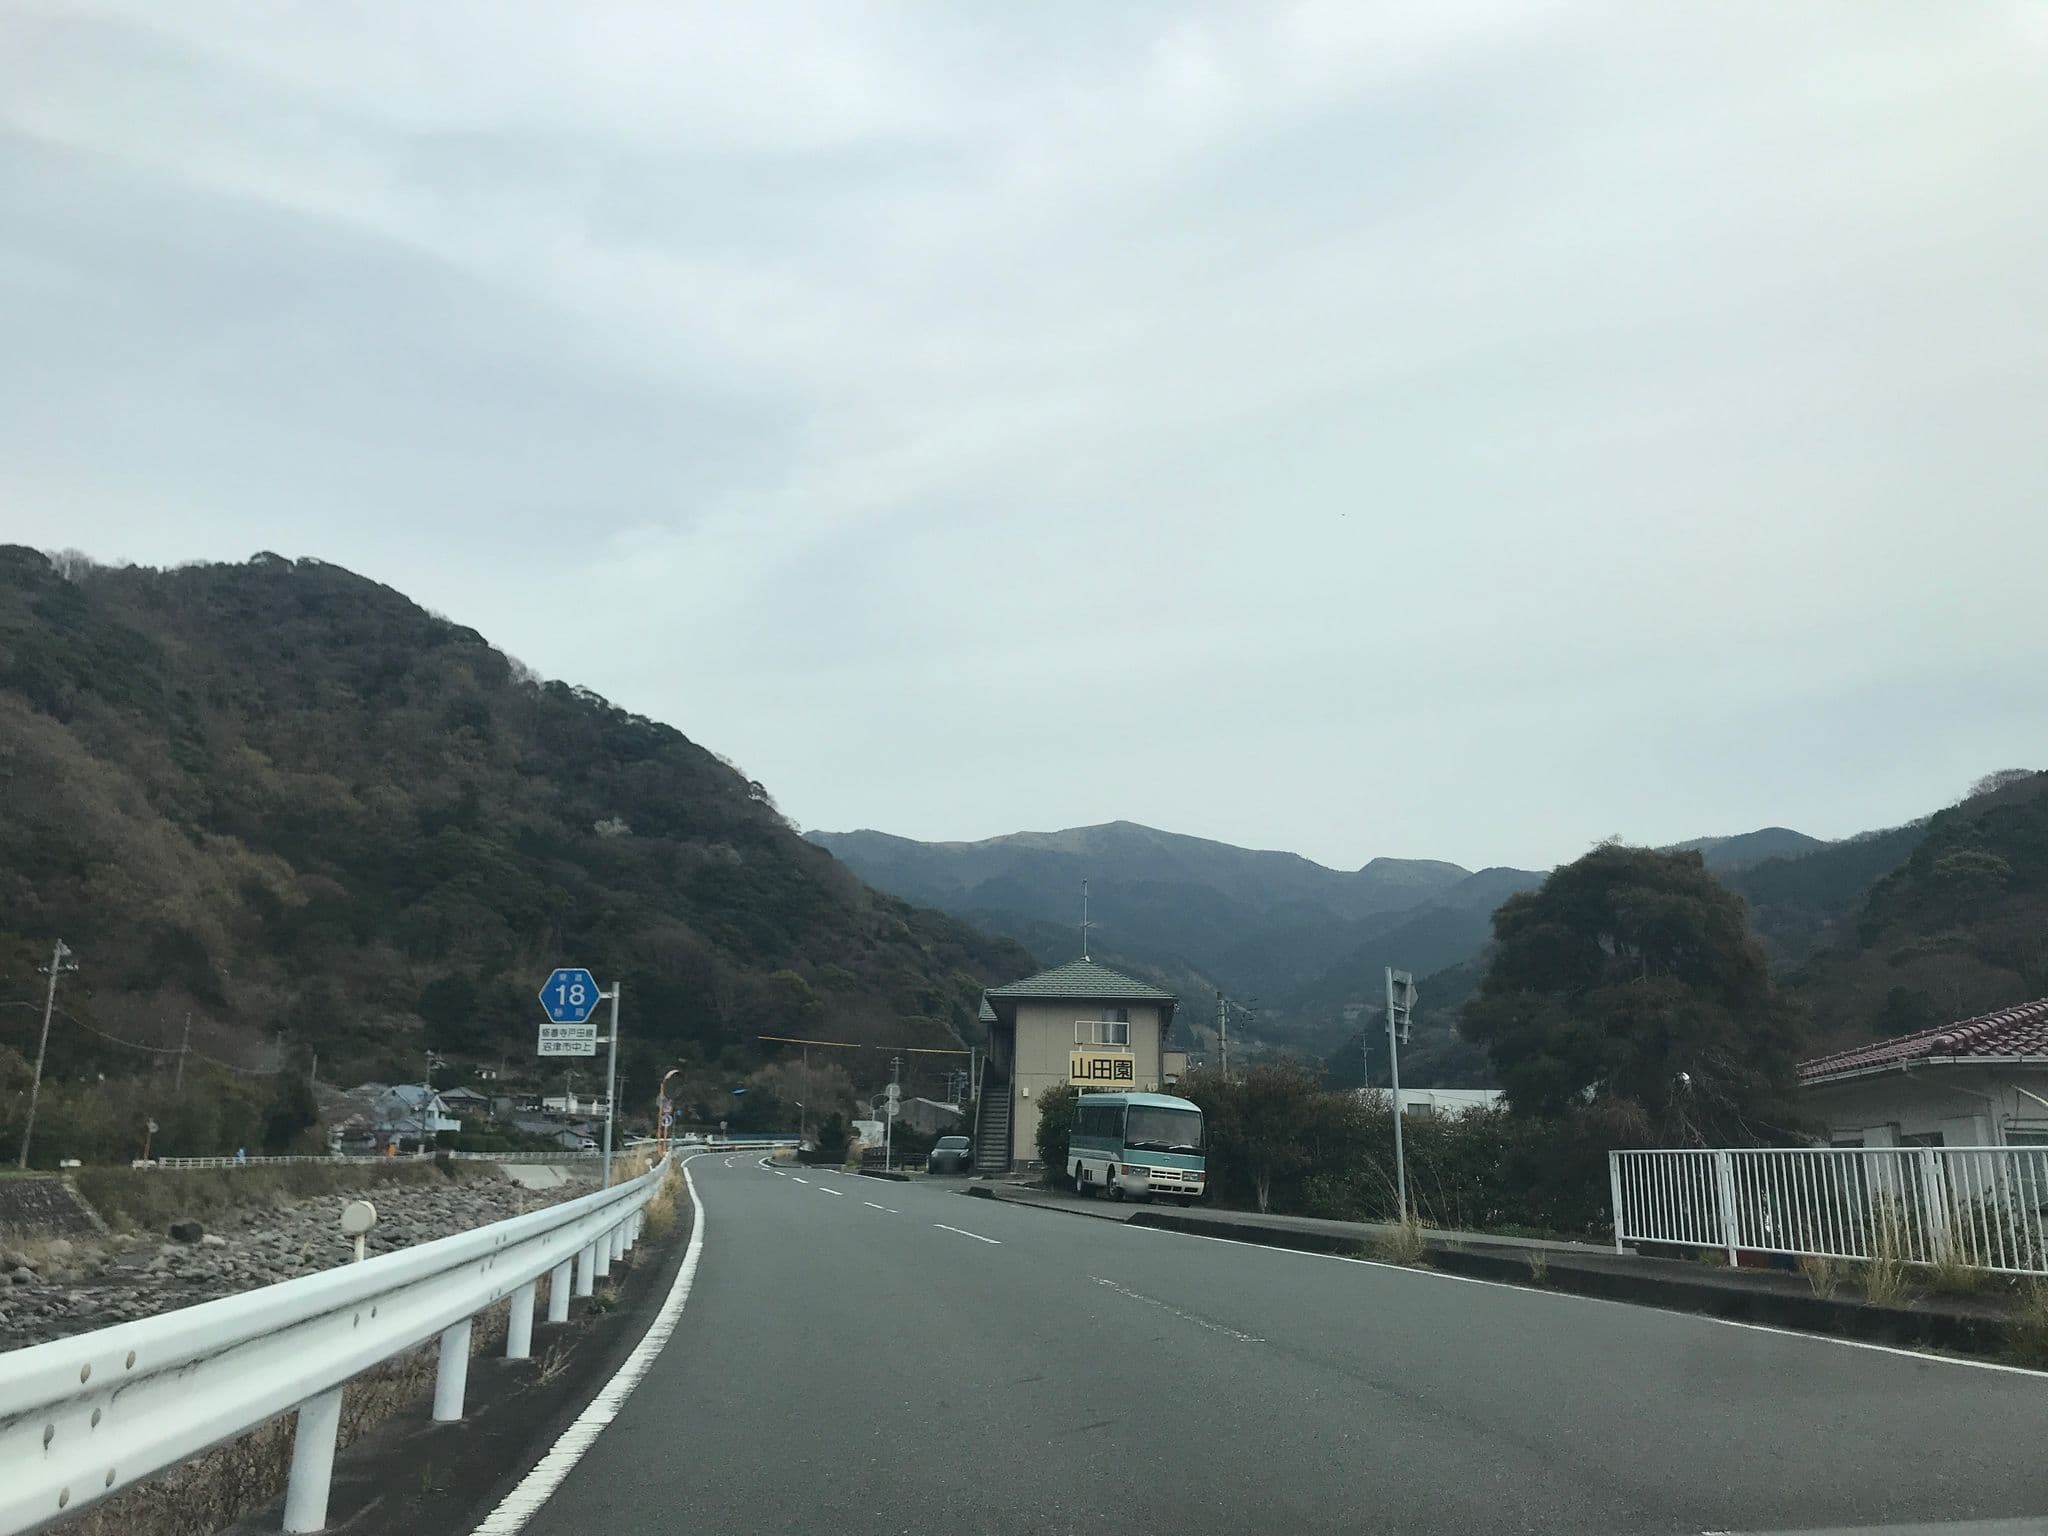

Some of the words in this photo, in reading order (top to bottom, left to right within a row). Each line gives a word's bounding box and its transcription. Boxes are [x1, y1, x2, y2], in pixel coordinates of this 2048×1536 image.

[555, 984, 585, 1006] 18
[1072, 1057, 1133, 1081] 山田園
